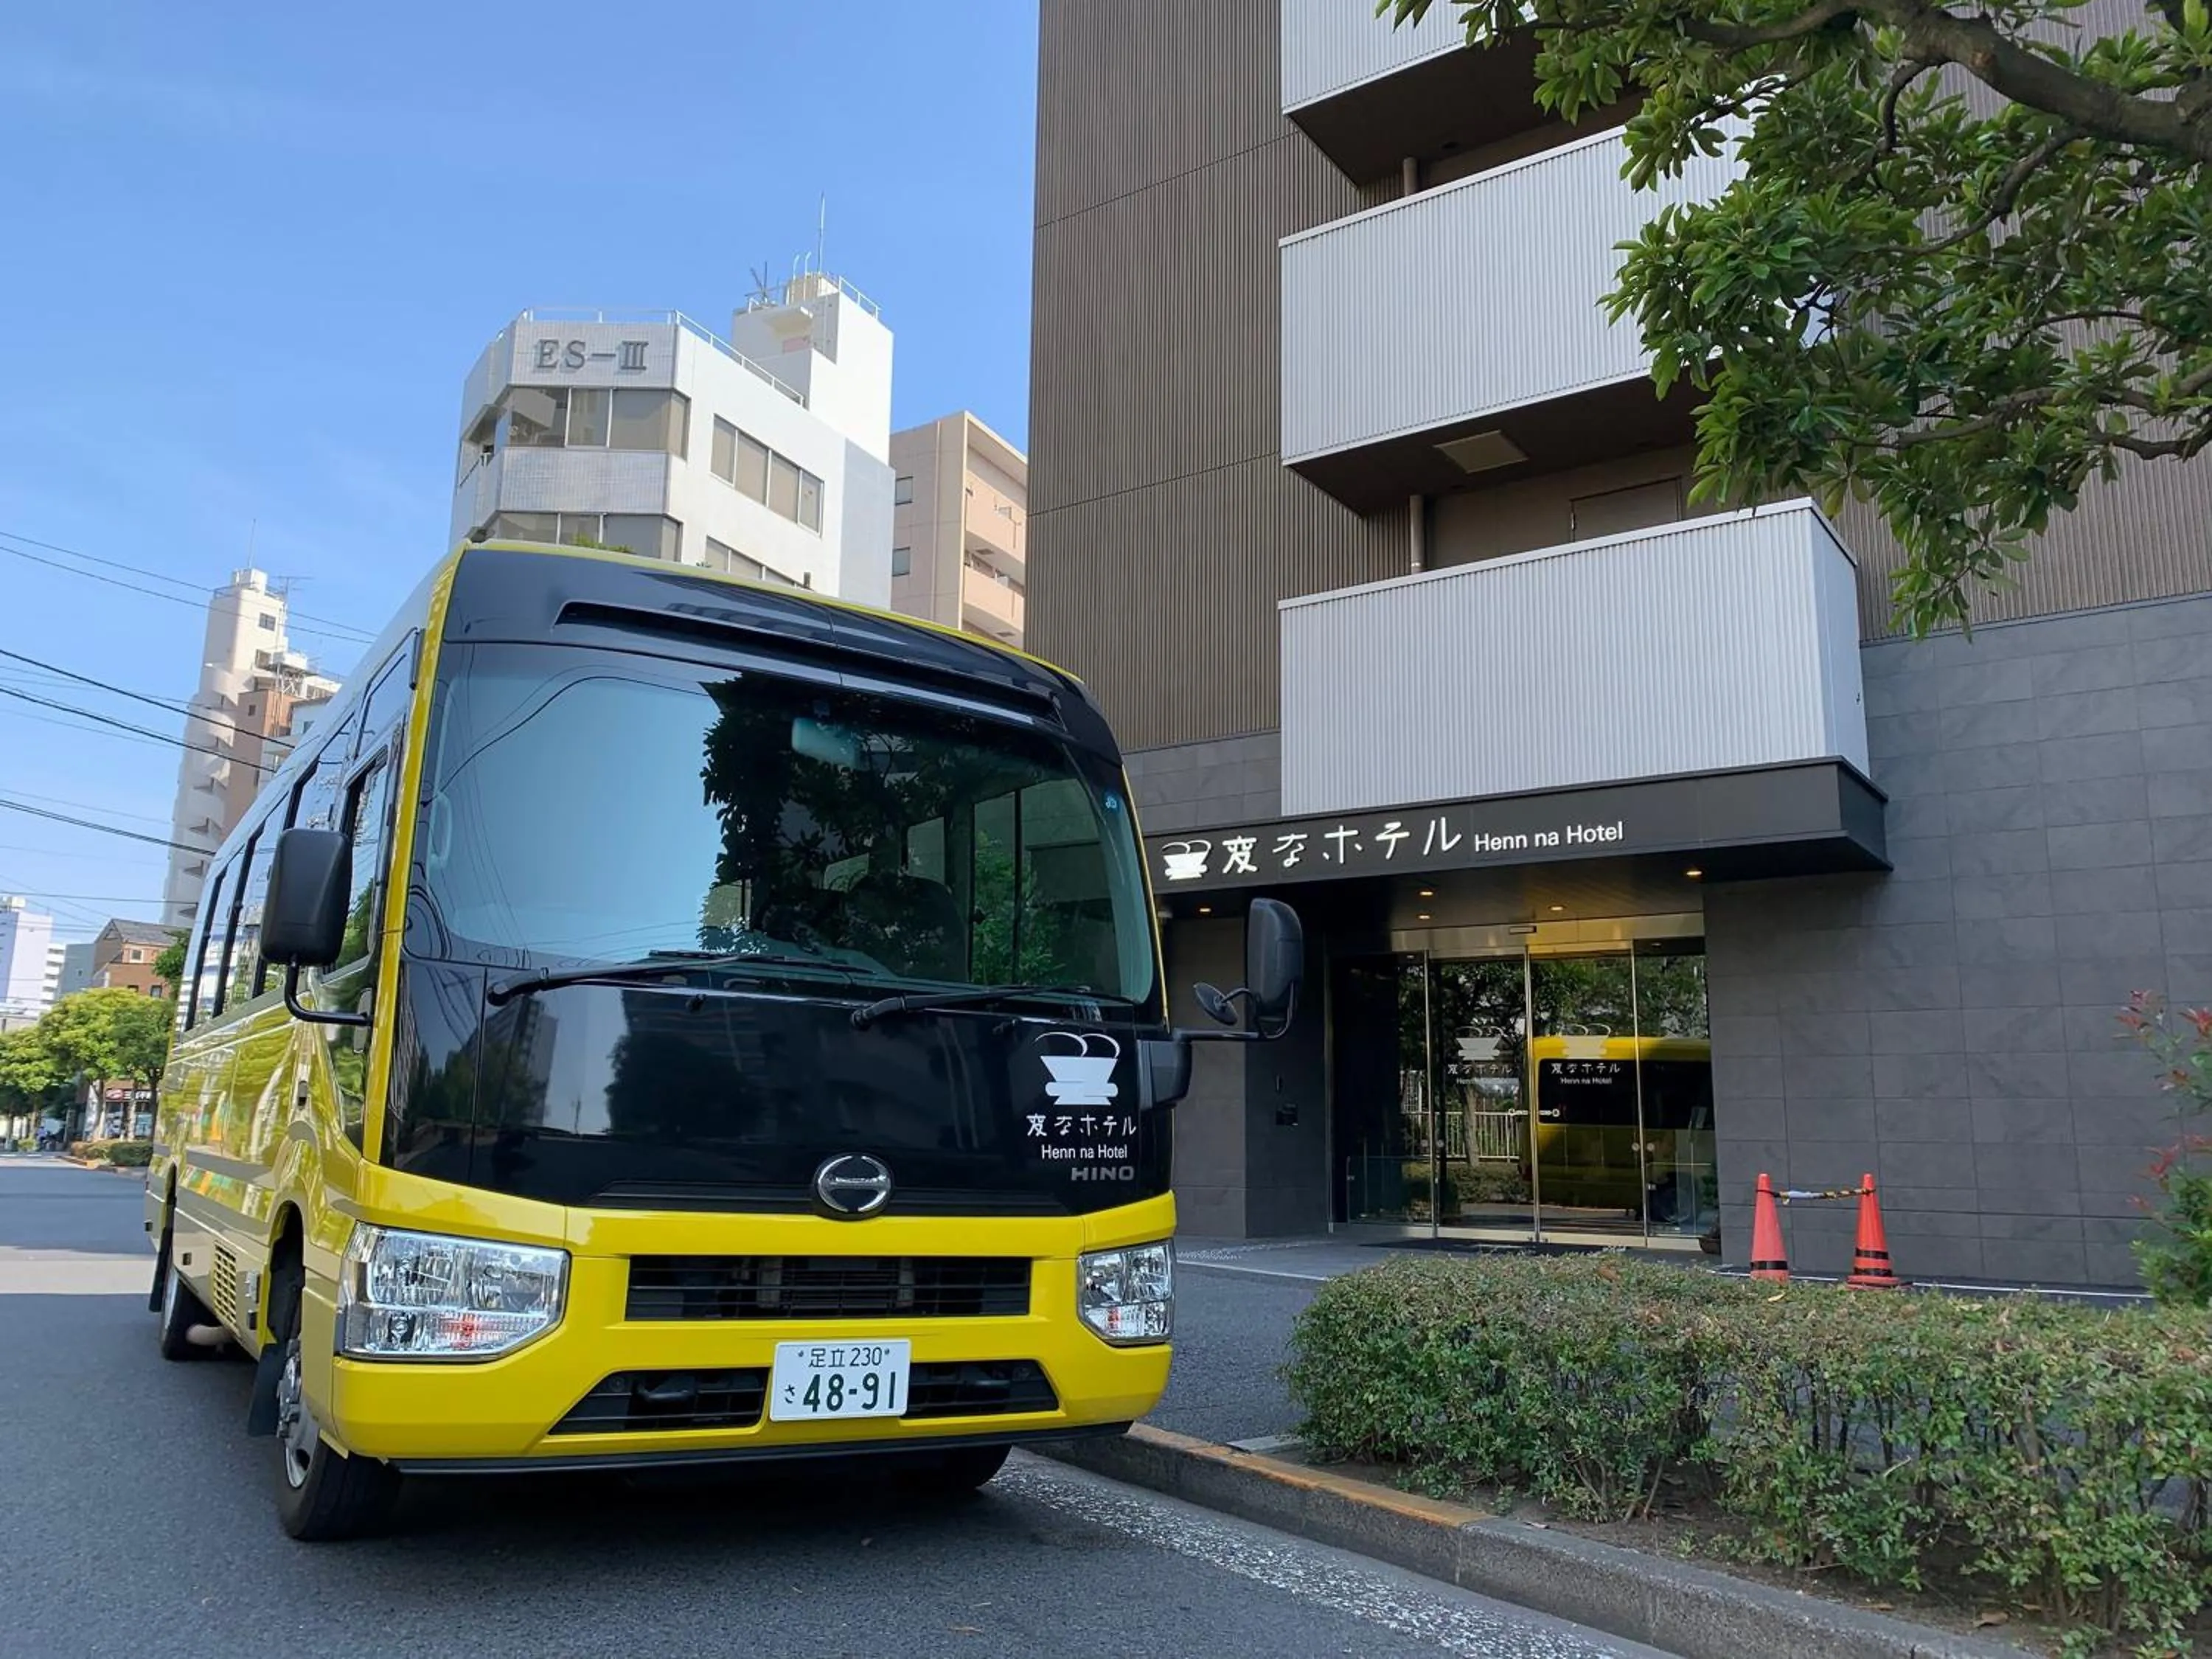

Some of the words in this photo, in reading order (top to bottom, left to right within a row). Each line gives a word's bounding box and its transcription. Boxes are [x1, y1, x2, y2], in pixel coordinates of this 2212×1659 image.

[1222, 816, 1462, 874] 変なホテル
[1475, 832, 1528, 852] Henn
[1534, 831, 1559, 847] na
[1567, 820, 1624, 844] Hotel
[1551, 1062, 1621, 1074] 変なホテル
[1026, 1113, 1137, 1137] 変なホテル
[1041, 1144, 1076, 1160] Henn
[1080, 1147, 1095, 1159] na
[1098, 1144, 1128, 1159] Hotel
[1071, 1165, 1135, 1181] HINO
[784, 1383, 796, 1405] さ
[802, 1371, 897, 1413] 48-91
